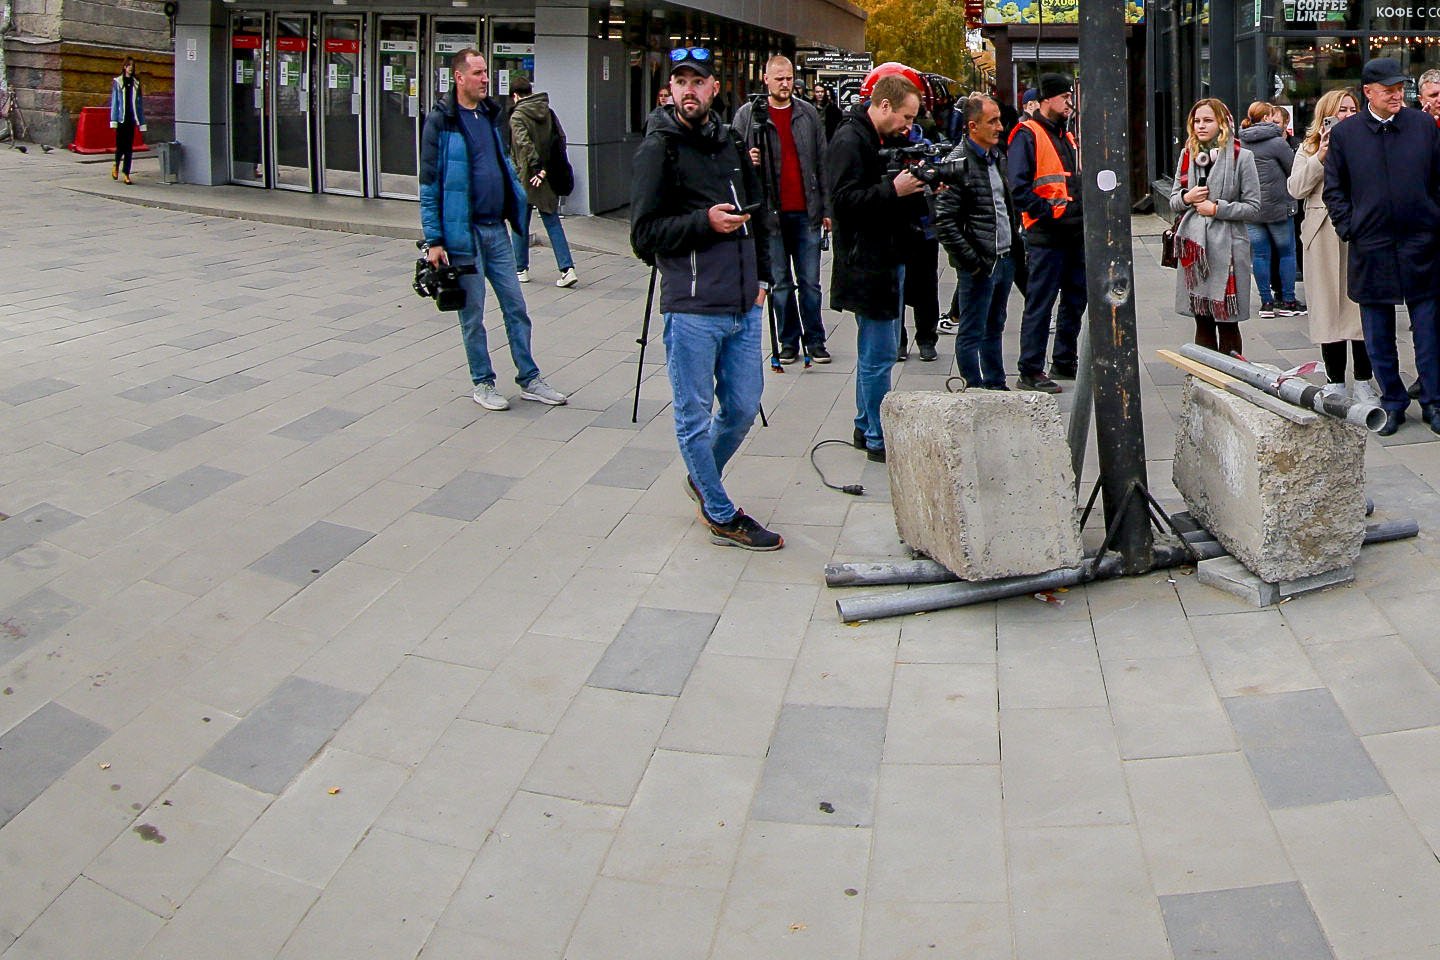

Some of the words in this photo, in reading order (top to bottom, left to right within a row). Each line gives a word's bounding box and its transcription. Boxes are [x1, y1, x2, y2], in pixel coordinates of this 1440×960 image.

[1297, 0, 1348, 11] COFFEE
[1296, 10, 1327, 22] LIKE
[1376, 6, 1413, 18] КОФЕ
[1416, 7, 1425, 18] С
